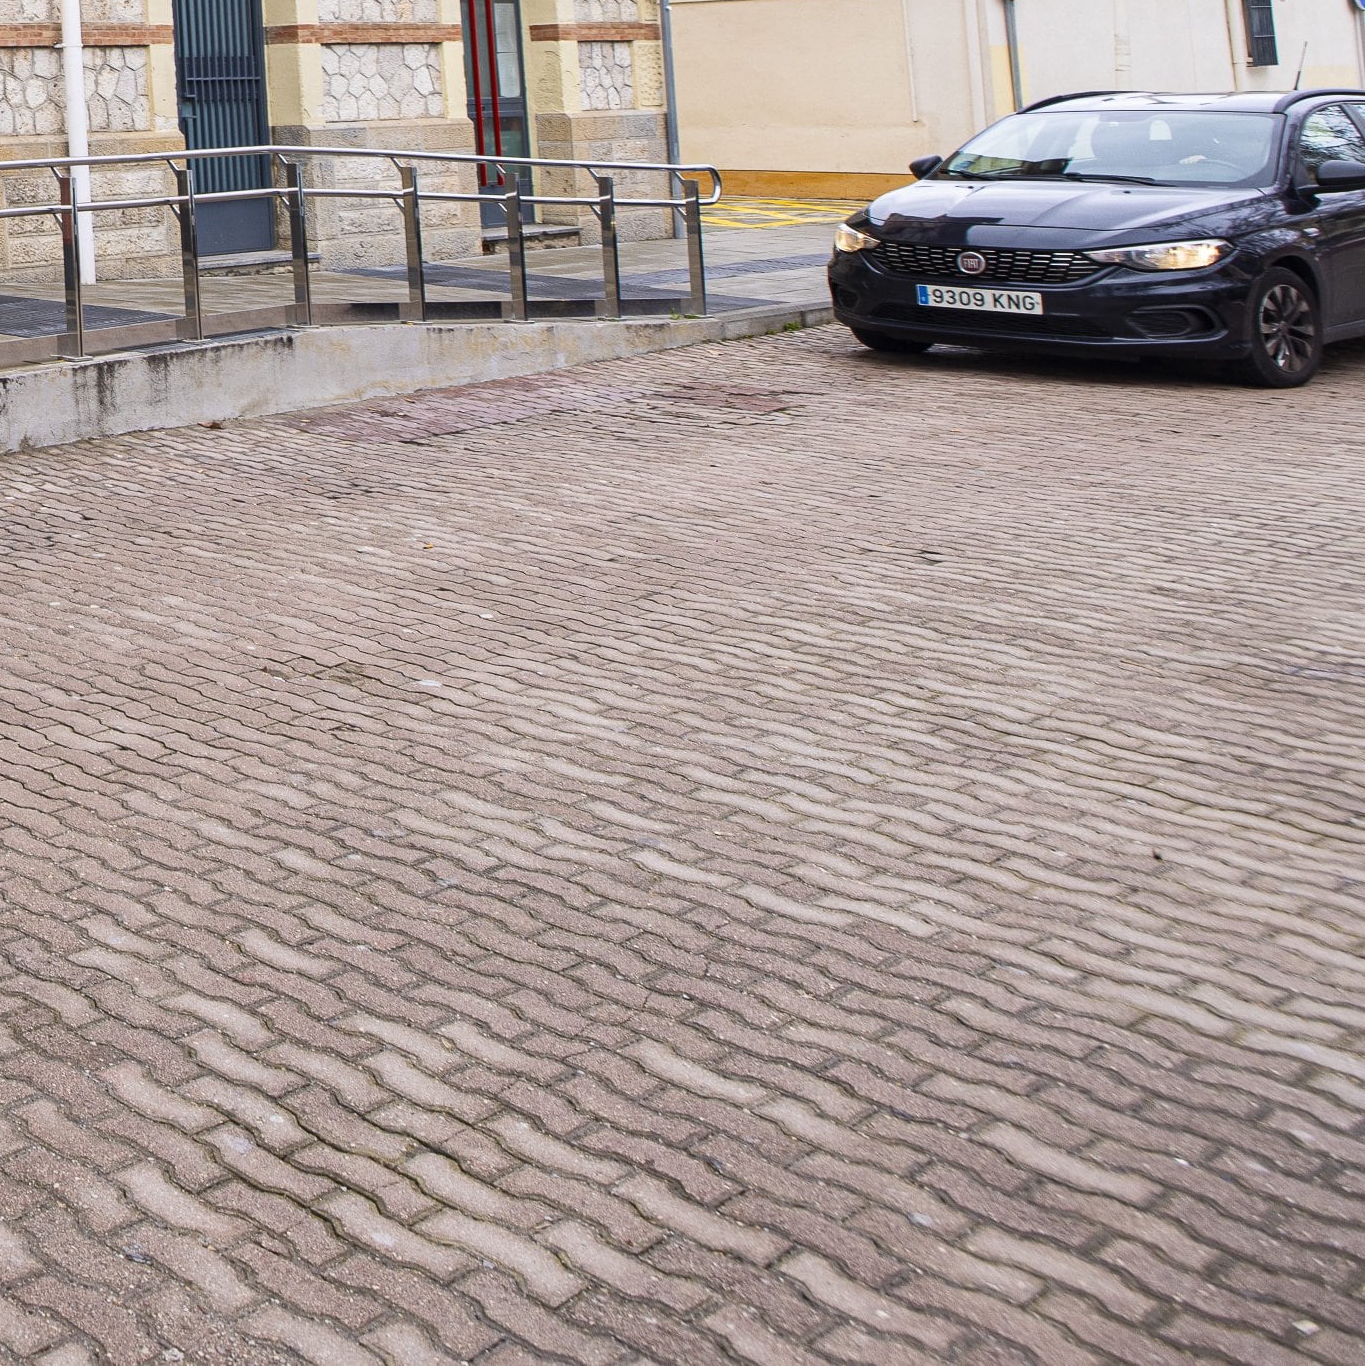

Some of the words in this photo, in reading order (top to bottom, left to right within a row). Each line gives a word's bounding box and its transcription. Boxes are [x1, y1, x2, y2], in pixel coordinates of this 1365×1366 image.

[963, 258, 979, 268] FIAT
[932, 288, 985, 307] 9309
[992, 293, 1035, 311] KNG
